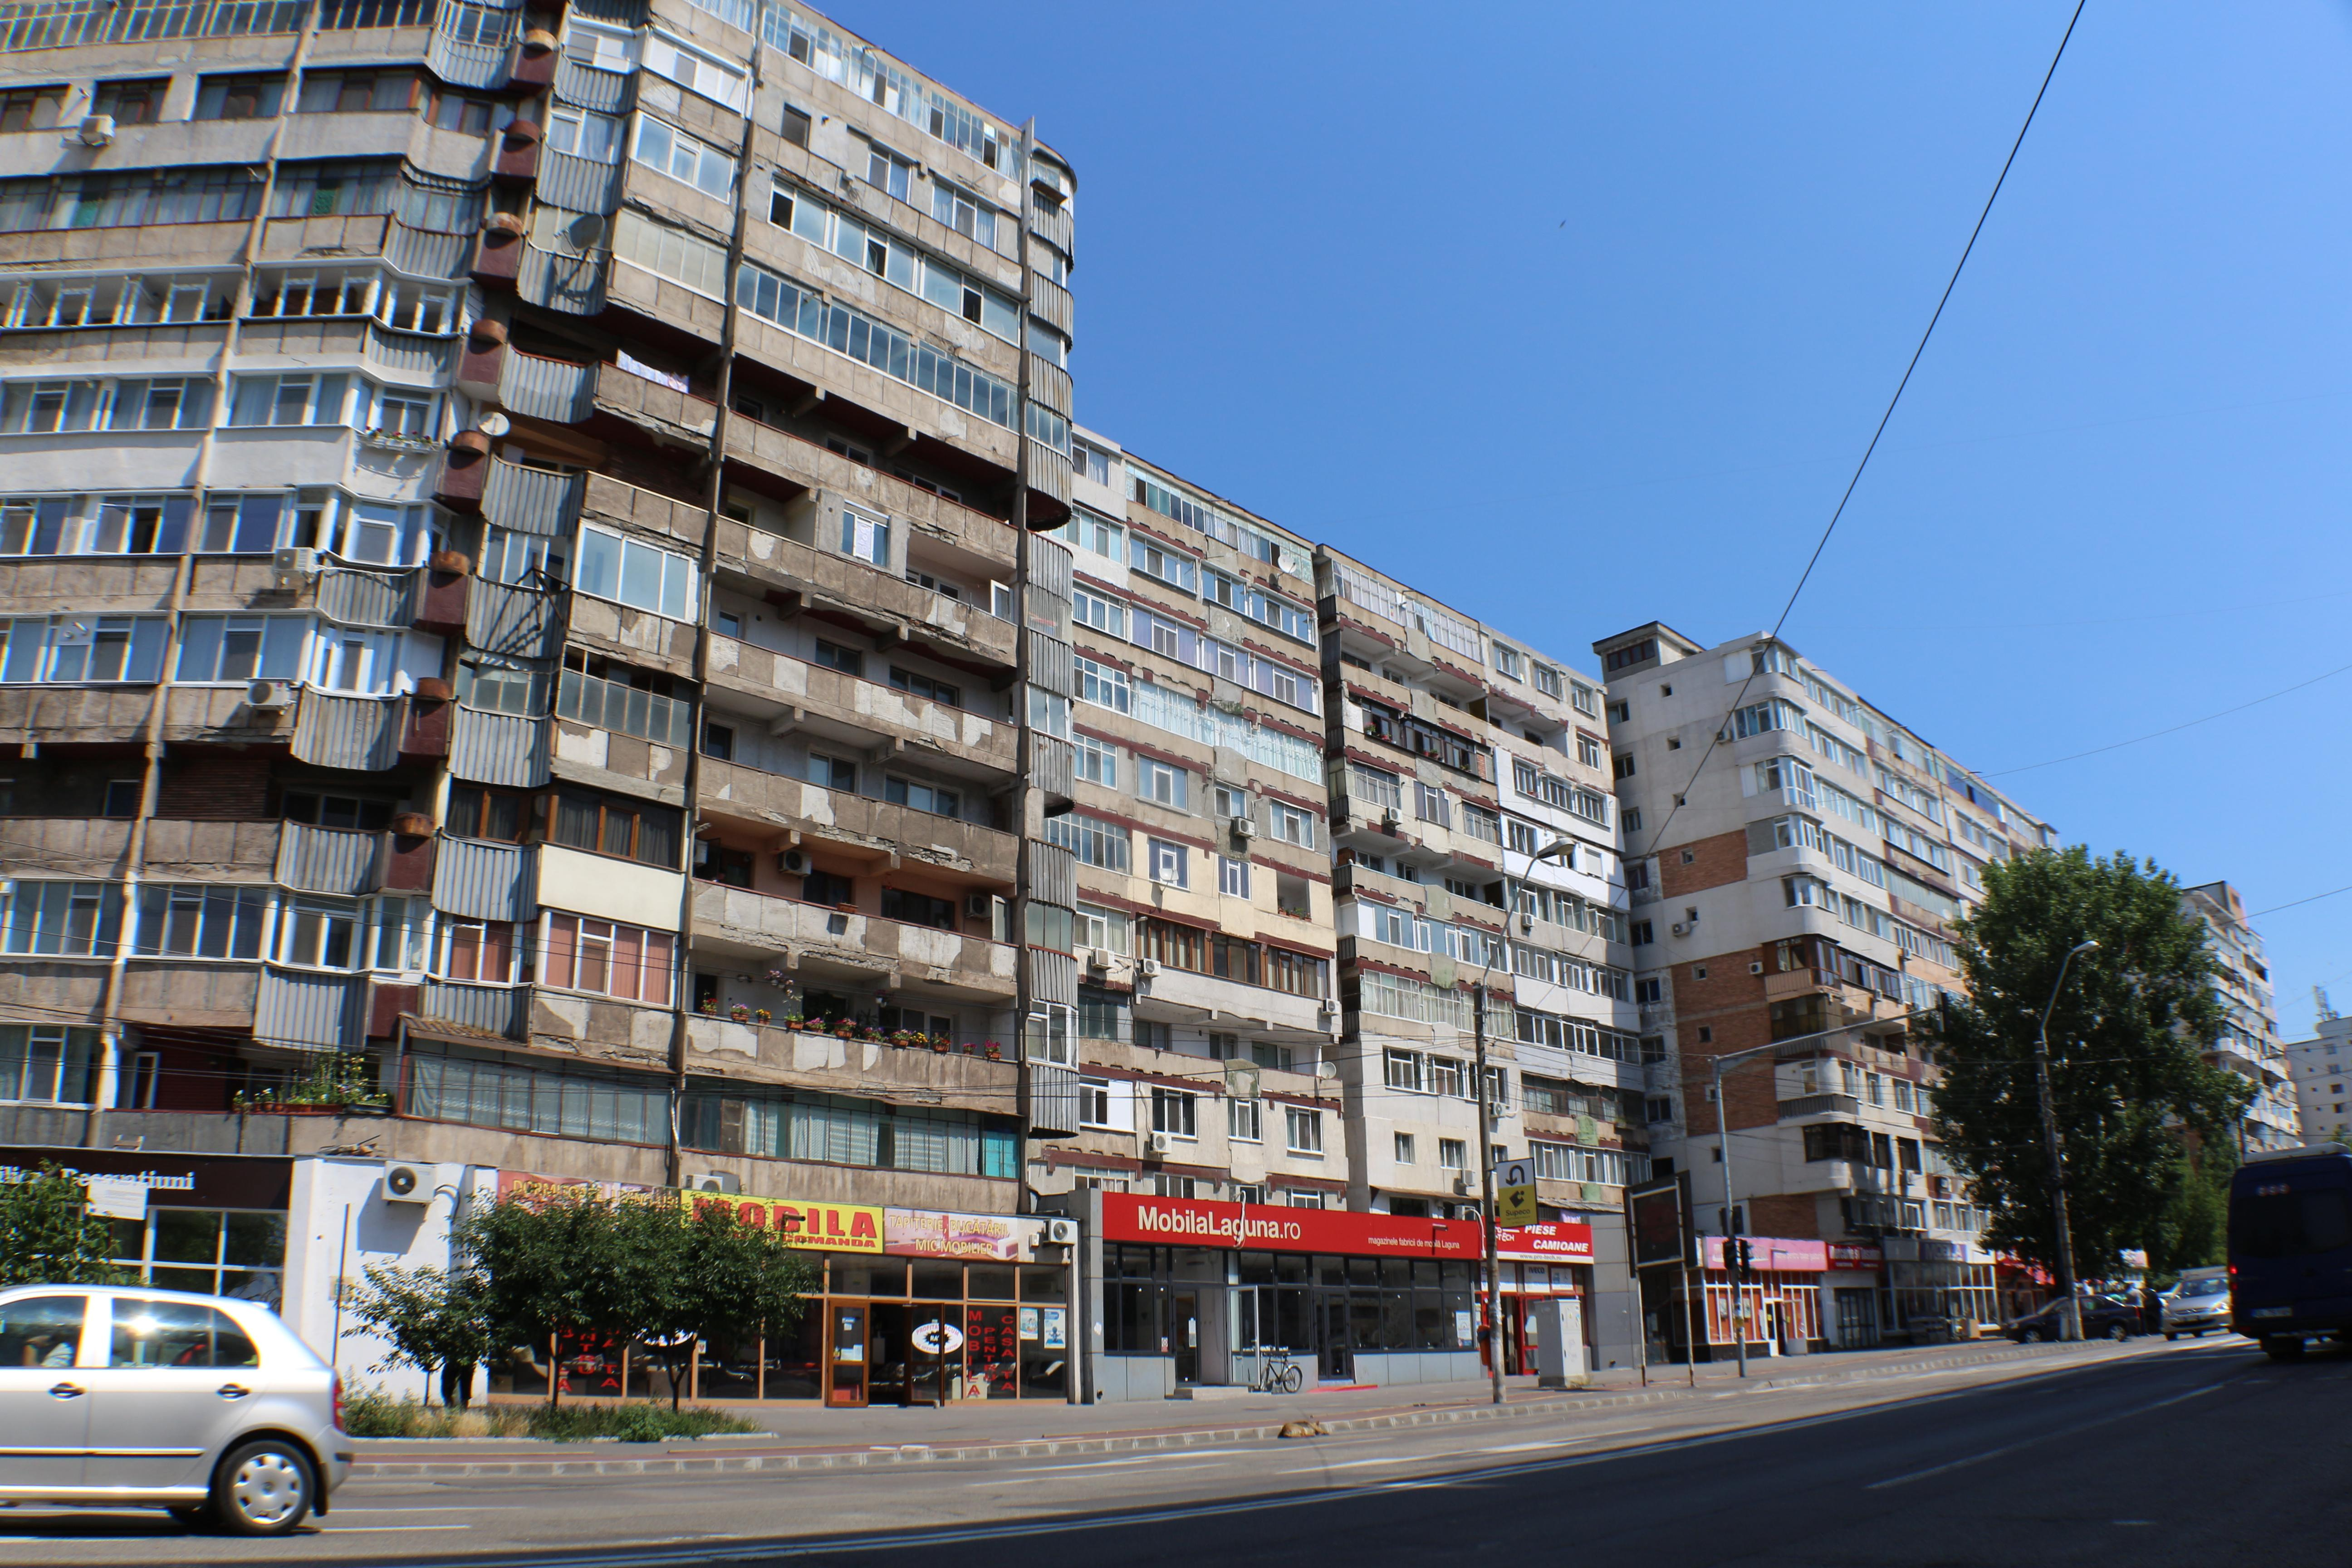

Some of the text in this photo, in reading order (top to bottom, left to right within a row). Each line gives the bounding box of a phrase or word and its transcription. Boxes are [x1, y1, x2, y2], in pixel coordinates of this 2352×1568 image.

[1505, 1209, 1531, 1217] Supeco
[1138, 1205, 1301, 1242] MobilaLaguna.ro
[1524, 1224, 1557, 1236] PIESE
[782, 1234, 876, 1248] COMANDA
[916, 1239, 994, 1255] MIC MOBILIER
[1368, 1237, 1398, 1247] magazinele
[1399, 1237, 1416, 1247] fabricii
[1441, 1240, 1460, 1250] Laguna
[1533, 1239, 1589, 1253] CAMIOANE
[1528, 1266, 1545, 1274] IVECO
[1001, 1315, 1015, 1357] CASA
[967, 1310, 983, 1398] MOBILA
[984, 1326, 997, 1382] PENTRU
